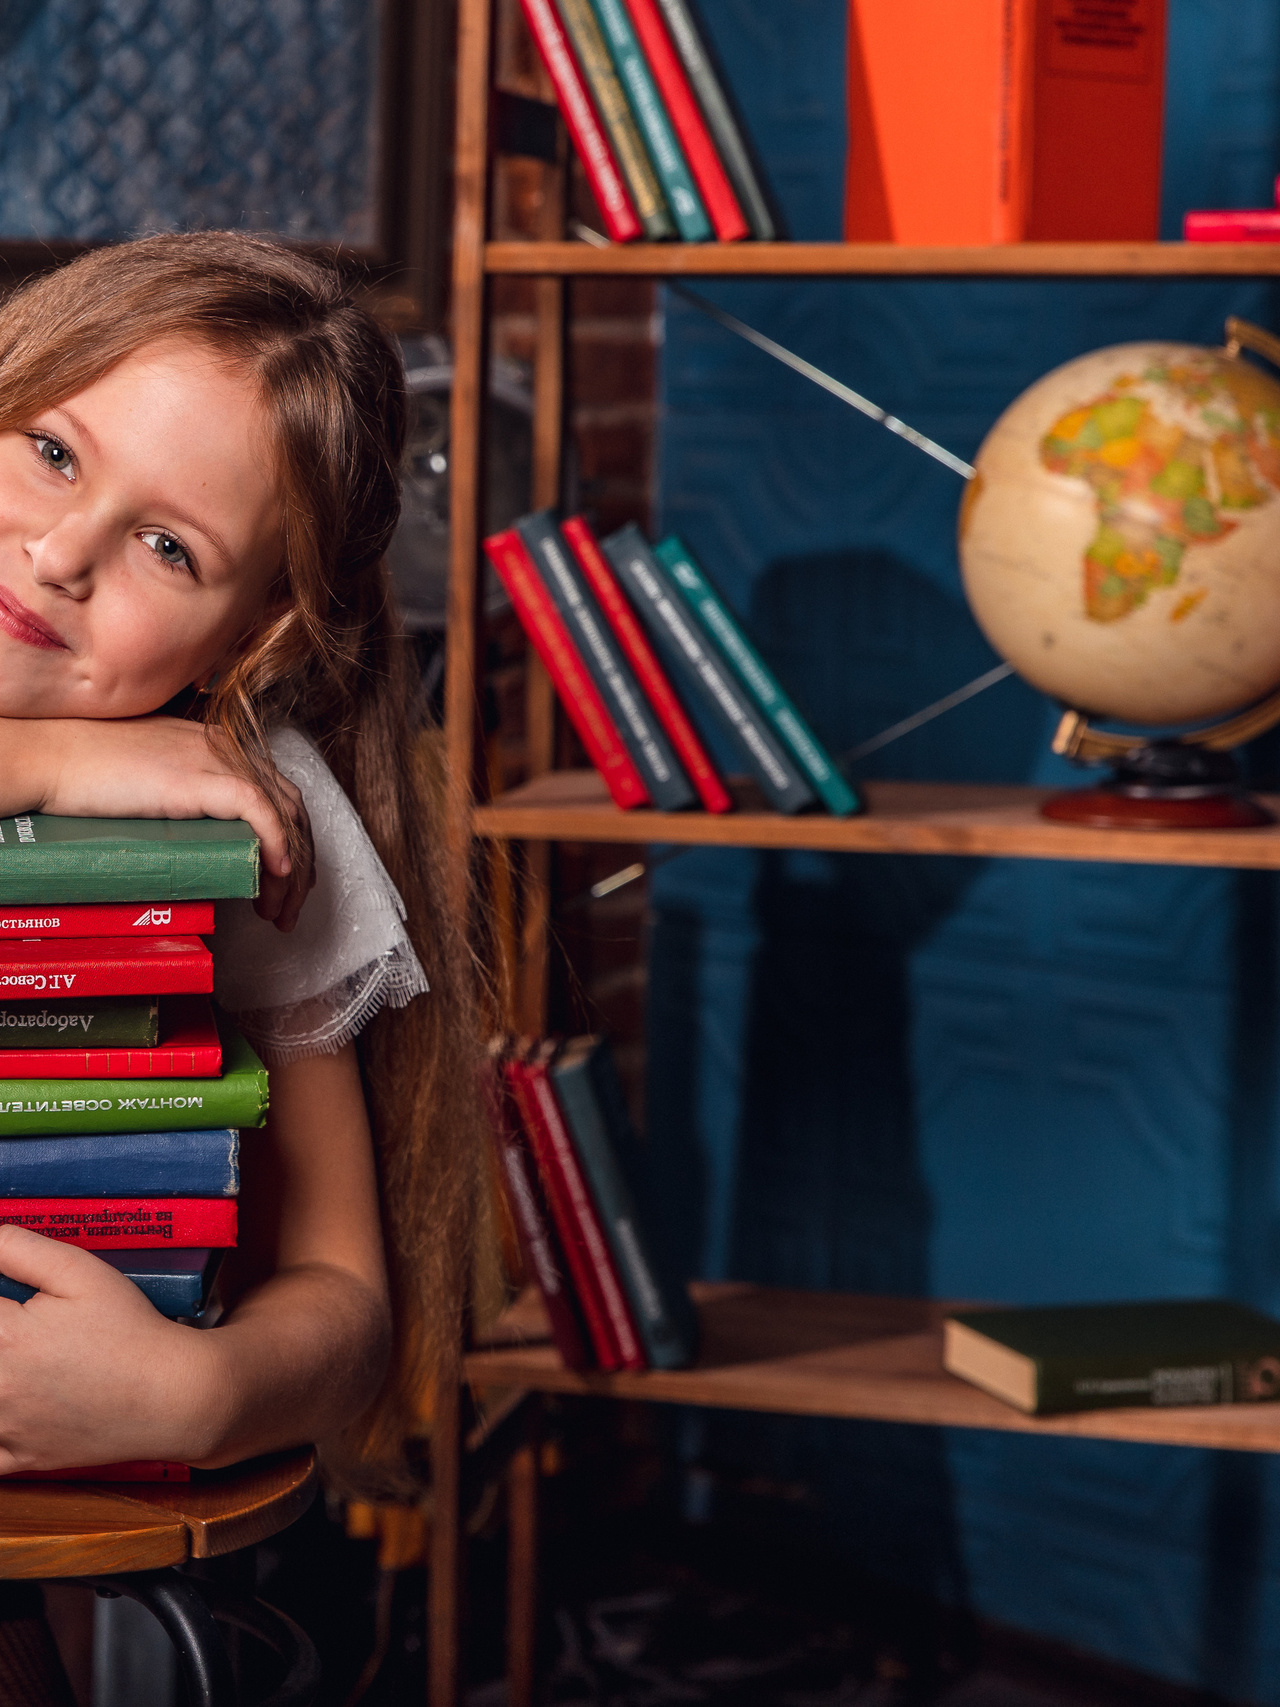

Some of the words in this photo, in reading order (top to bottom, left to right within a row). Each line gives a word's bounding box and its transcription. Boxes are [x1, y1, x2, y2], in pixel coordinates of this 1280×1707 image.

[117, 1096, 204, 1111] МОНТАЖ
[49, 1209, 152, 1225] предприятиях
[155, 1211, 173, 1222] на
